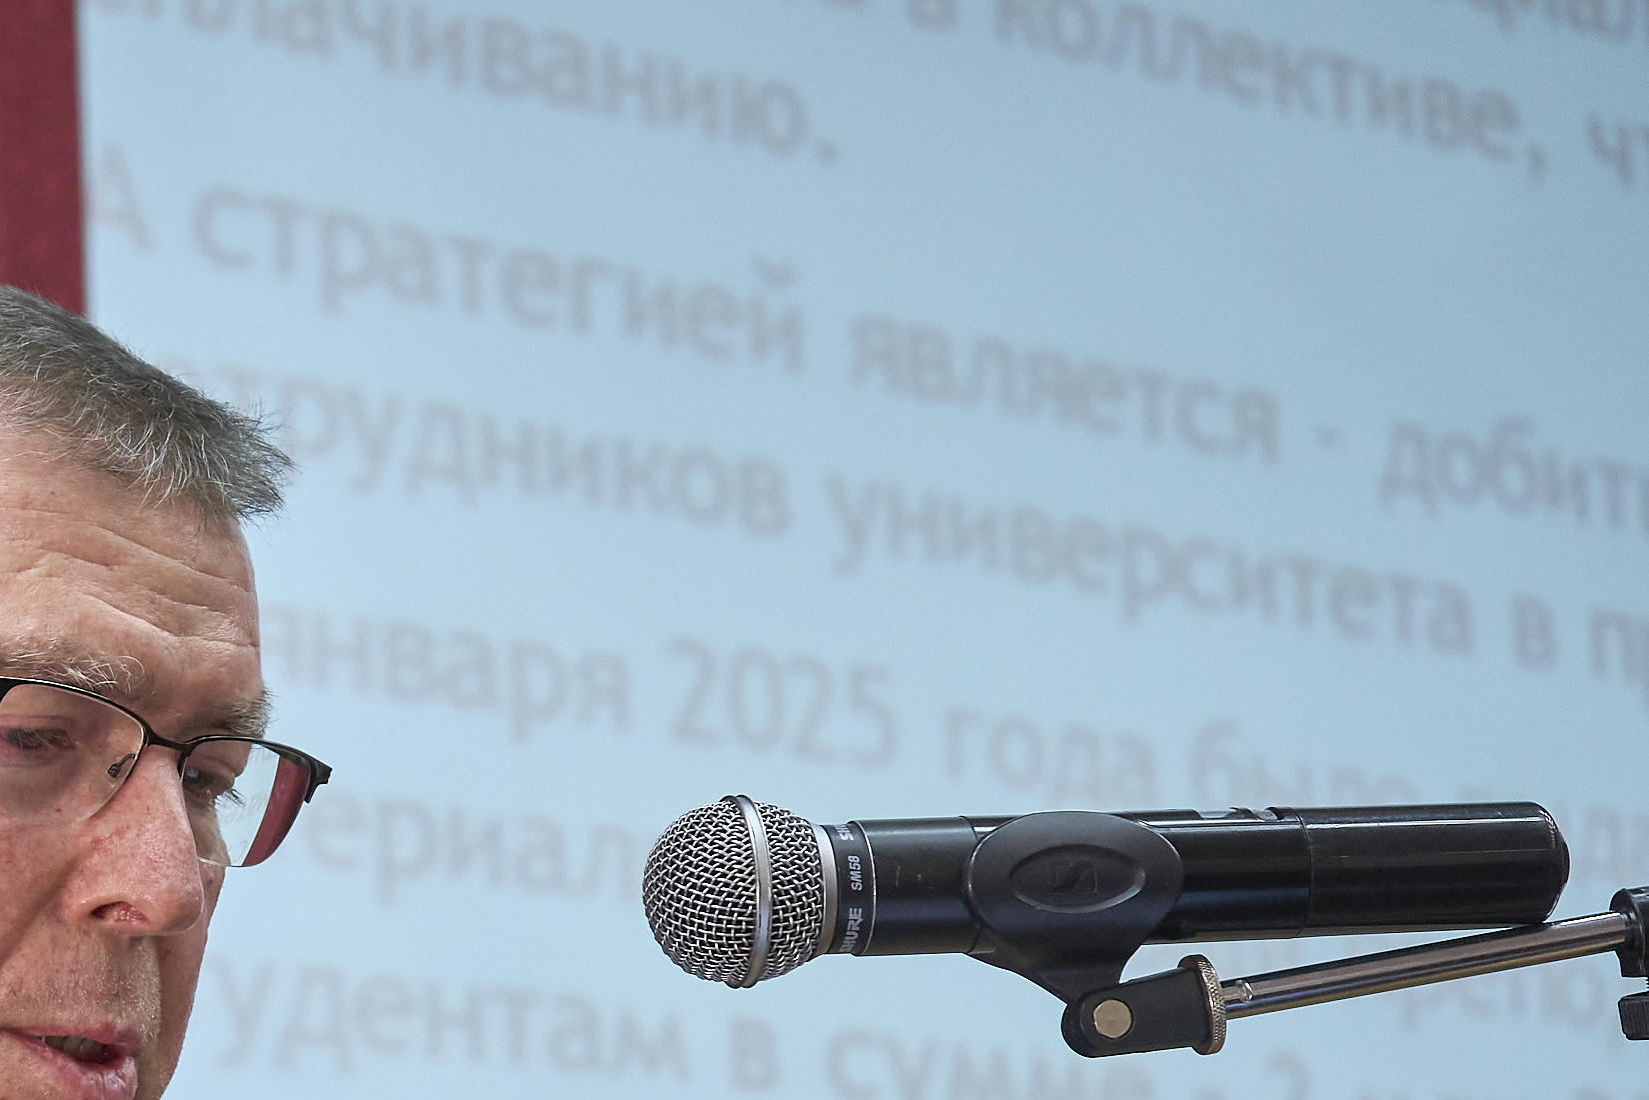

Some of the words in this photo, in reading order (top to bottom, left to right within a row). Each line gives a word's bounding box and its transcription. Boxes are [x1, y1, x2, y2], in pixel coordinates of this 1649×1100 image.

[190, 188, 807, 374] стратегией
[850, 315, 1278, 465] является
[826, 474, 1474, 659] университета
[1512, 596, 1555, 672] в
[670, 638, 898, 770] 2025
[947, 706, 1154, 808] года
[848, 855, 862, 891] SM58
[730, 1017, 780, 1094] в
